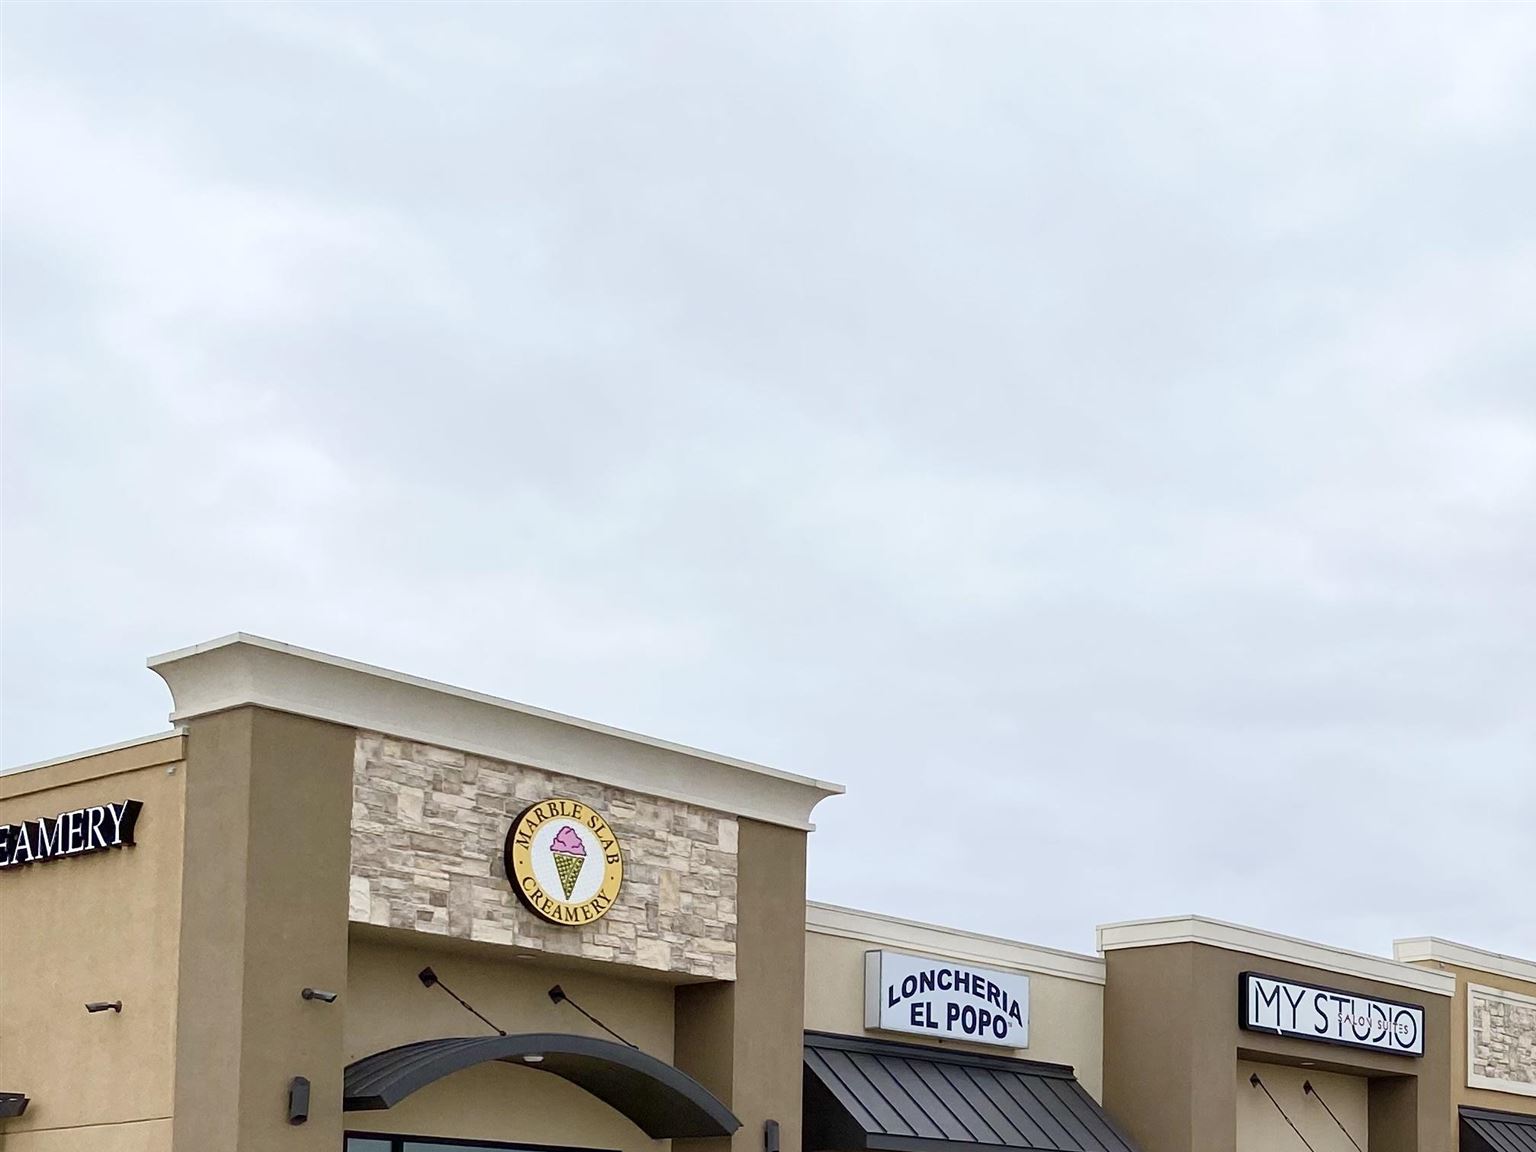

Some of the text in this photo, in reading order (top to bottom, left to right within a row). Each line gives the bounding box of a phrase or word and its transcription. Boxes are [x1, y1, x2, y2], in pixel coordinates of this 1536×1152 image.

[514, 801, 620, 864] MARBLE SLAB
[522, 876, 611, 922] CREAMERY
[888, 968, 1023, 1028] LONCHERIA
[910, 1002, 1008, 1039] EL POPO
[1254, 980, 1417, 1049] MY STUDIO
[1338, 1012, 1409, 1035] SALON SUITES
